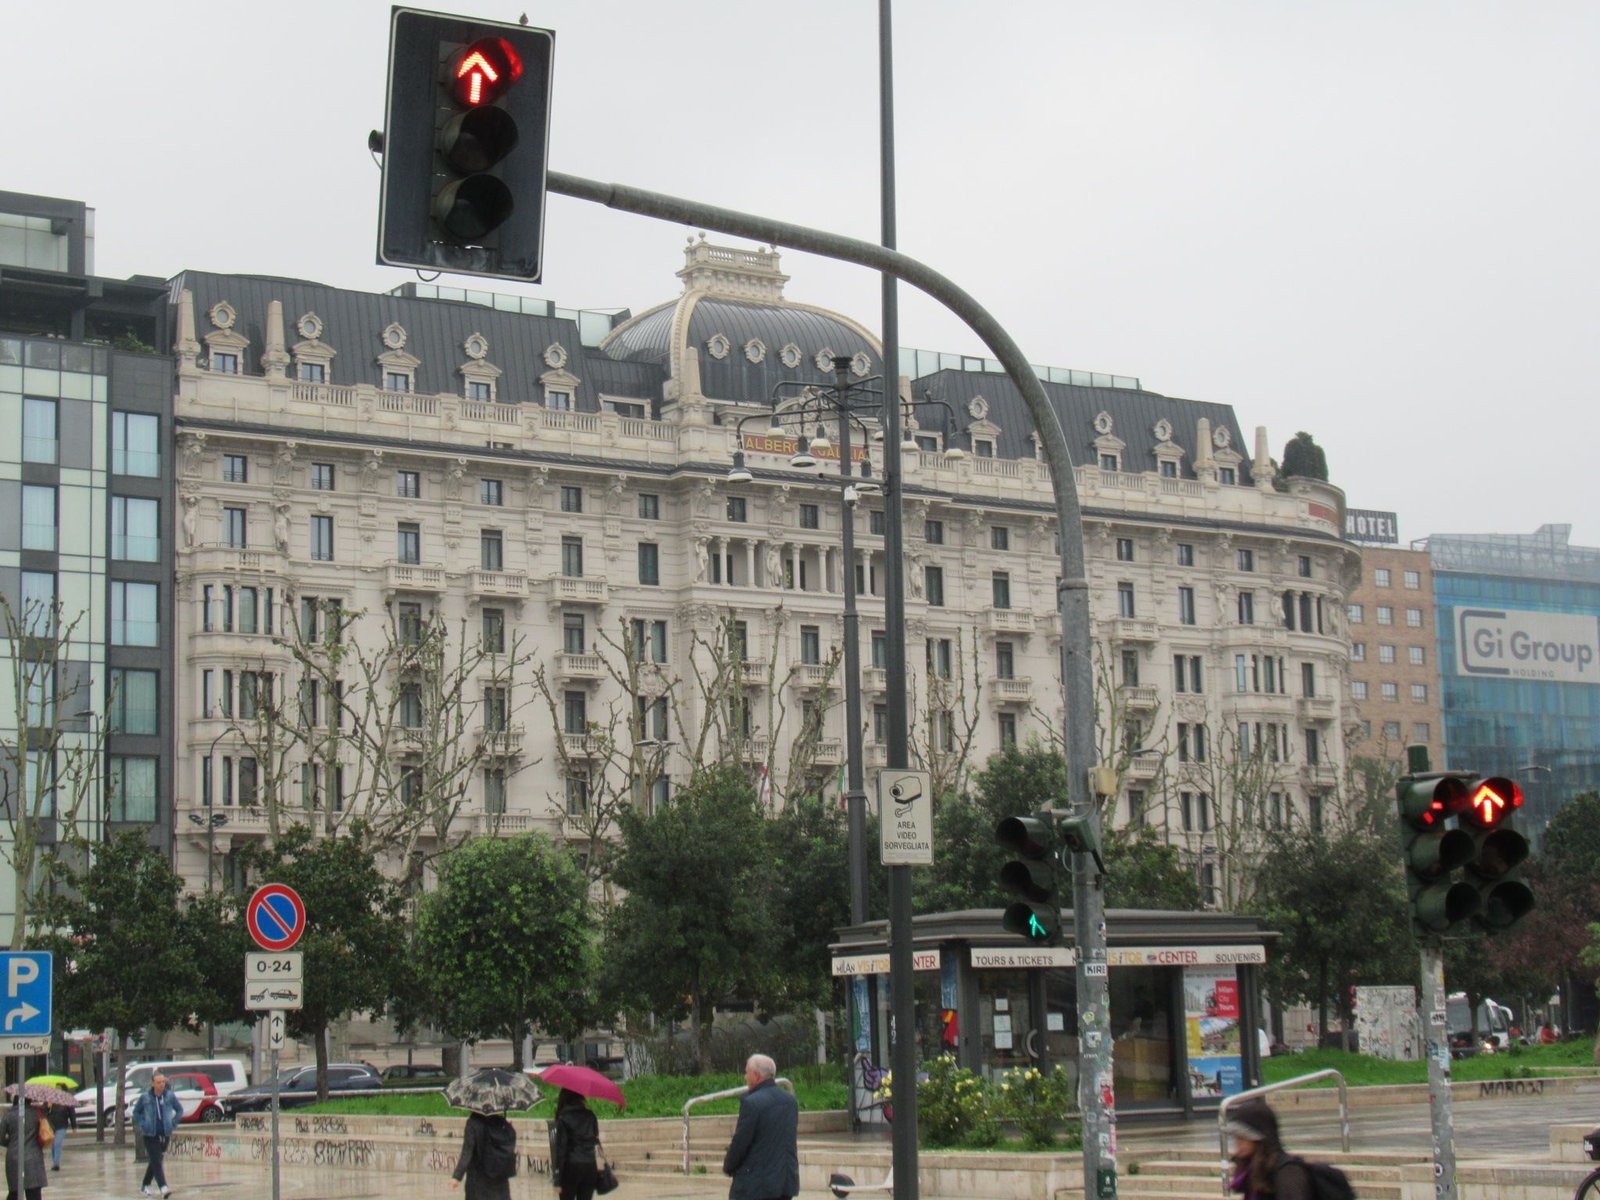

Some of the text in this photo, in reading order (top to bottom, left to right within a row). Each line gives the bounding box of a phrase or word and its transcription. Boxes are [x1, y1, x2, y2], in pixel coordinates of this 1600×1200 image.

[1346, 515, 1395, 537] HOTEL
[1474, 627, 1593, 673] Gi Group
[1513, 669, 1555, 678] HOLDING
[897, 821, 916, 829] AREA
[884, 842, 930, 850] SORVEGLIATA
[913, 955, 936, 969] NTER
[976, 955, 1053, 966] TOURS & TICKETS
[1158, 951, 1198, 963] CENTER
[1215, 953, 1261, 963] SOUVENIRS
[257, 960, 292, 973] 0-24
[8, 957, 39, 998] P
